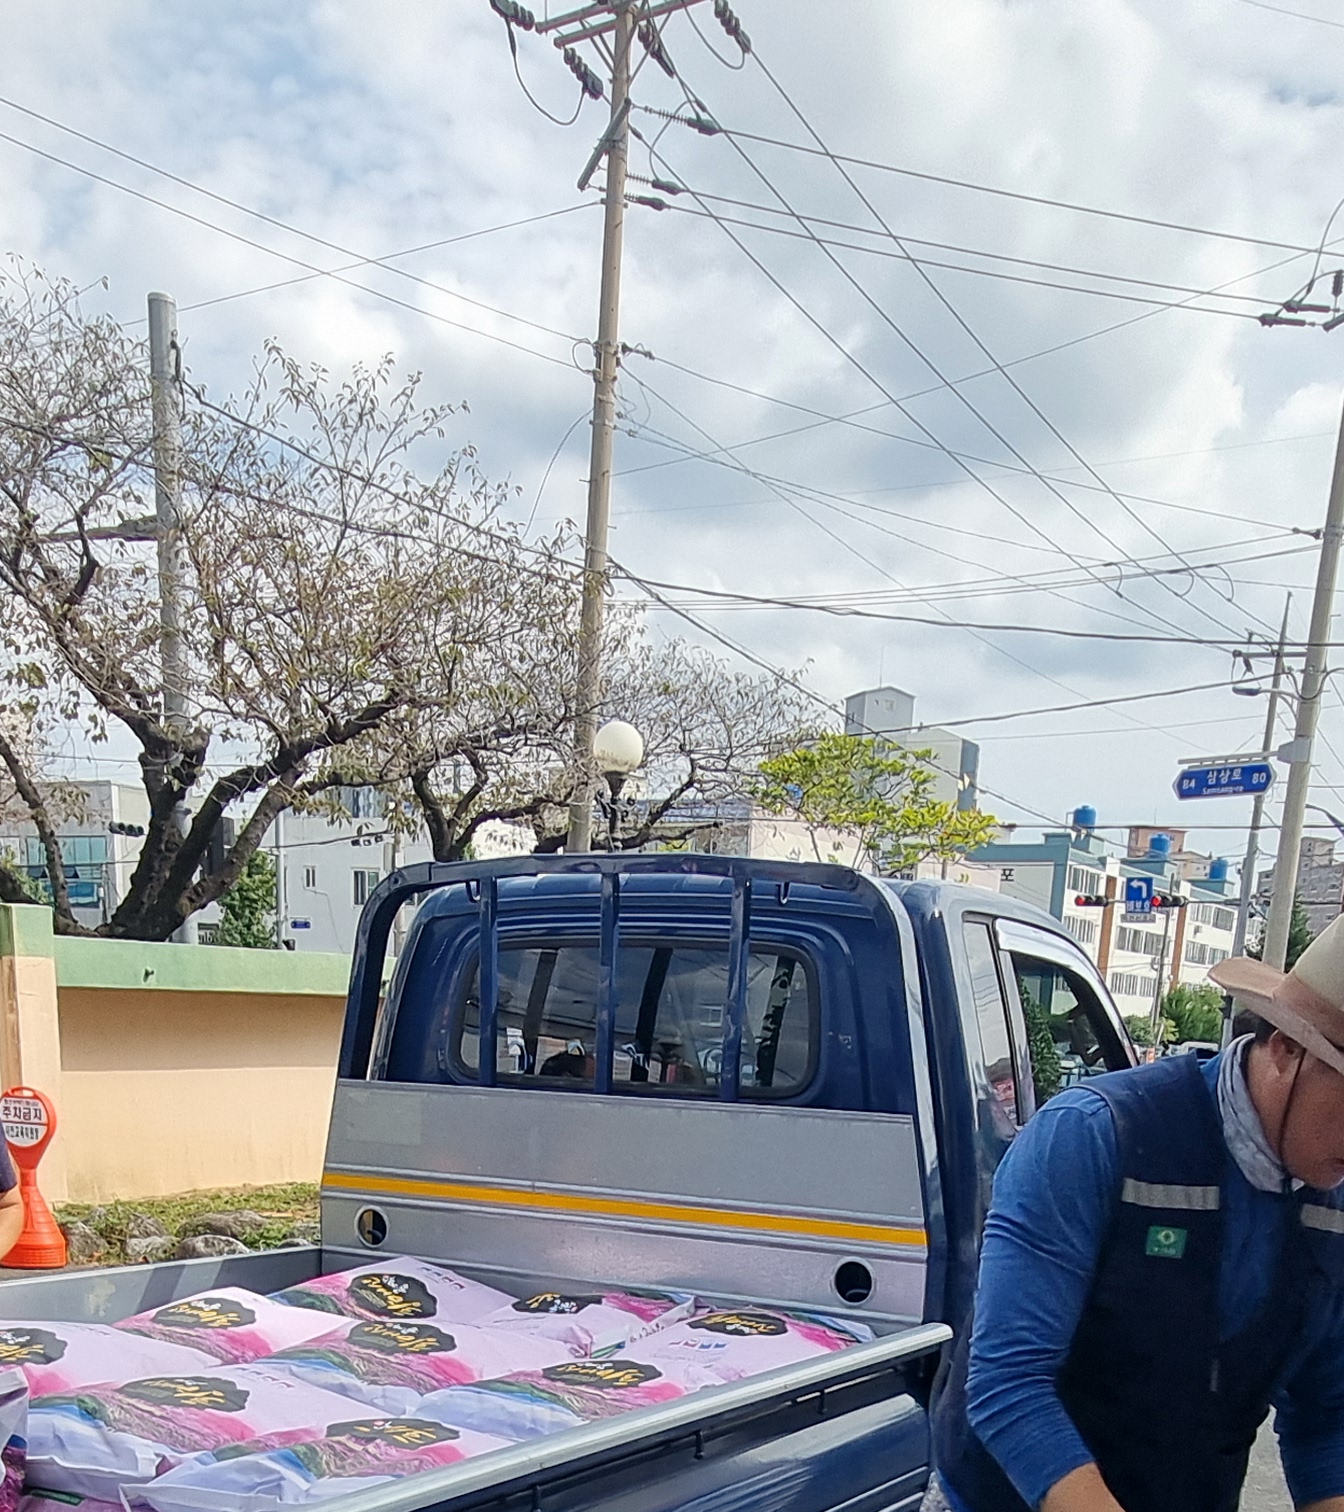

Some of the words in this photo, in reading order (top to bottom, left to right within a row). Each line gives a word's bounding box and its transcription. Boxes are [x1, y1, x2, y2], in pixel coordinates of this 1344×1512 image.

[1182, 778, 1196, 790] 84
[1206, 767, 1242, 785] 삼상로
[1252, 772, 1267, 784] 80
[2, 1105, 42, 1121] 주차금지
